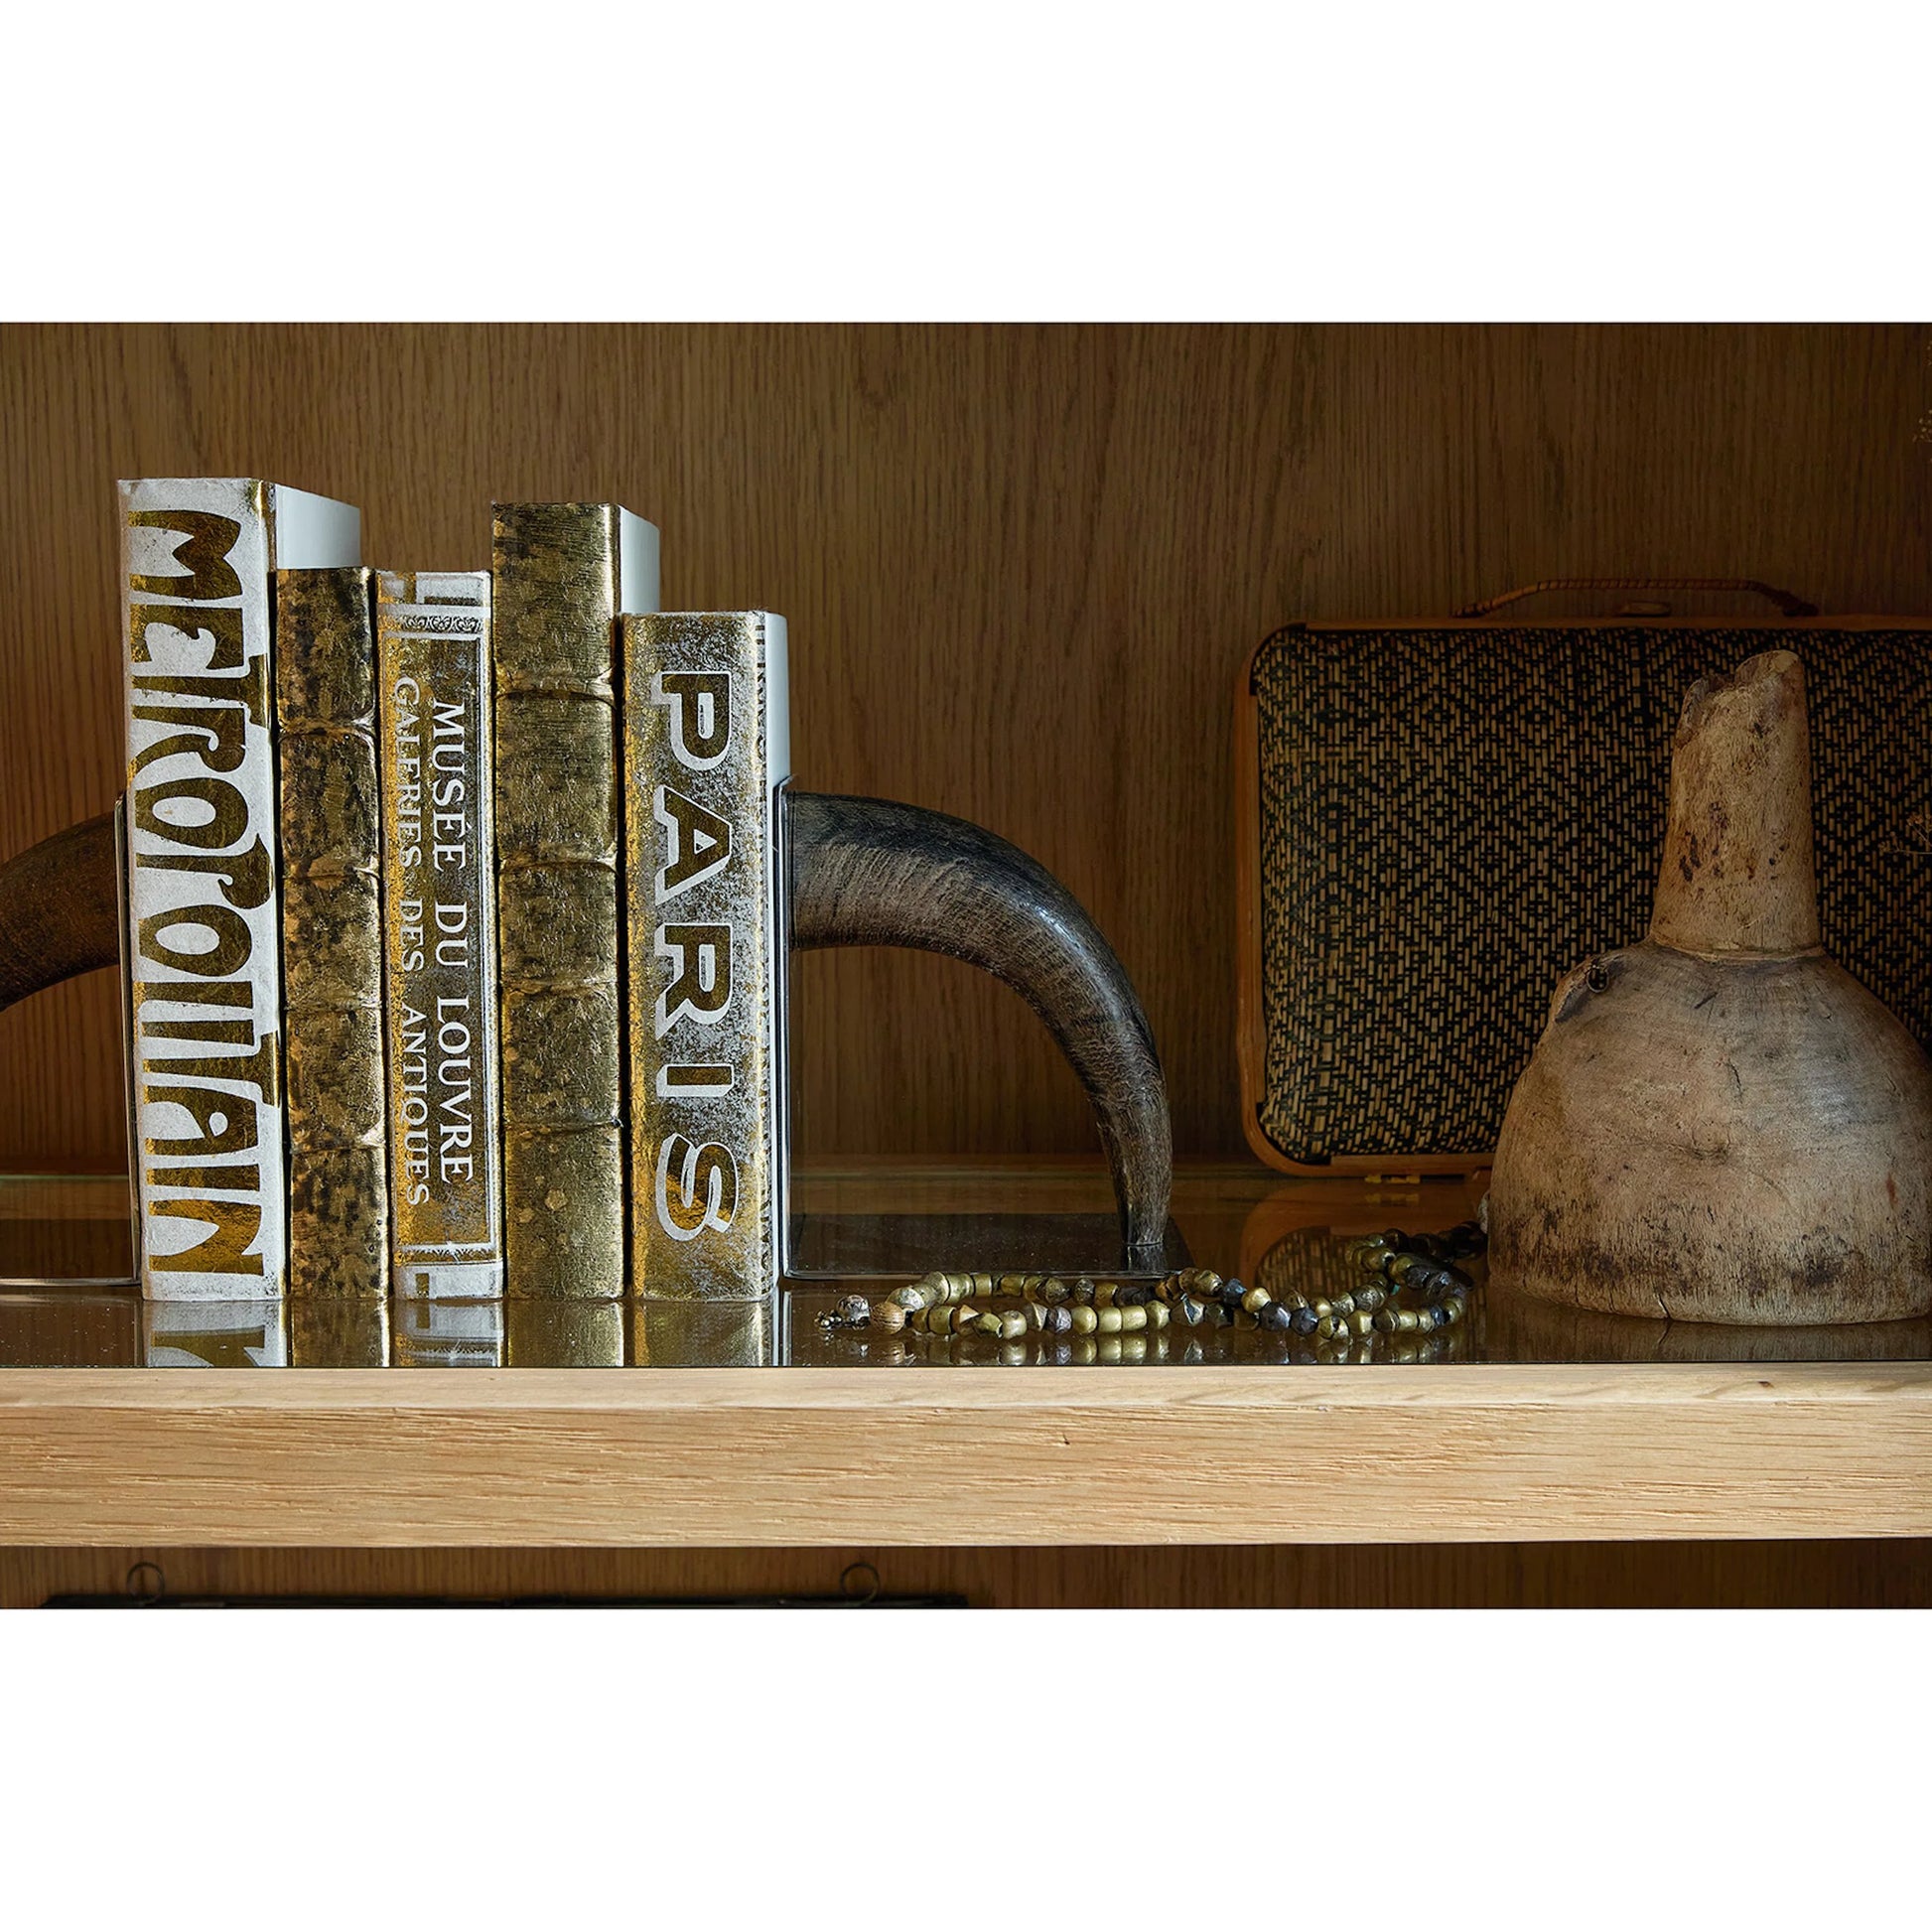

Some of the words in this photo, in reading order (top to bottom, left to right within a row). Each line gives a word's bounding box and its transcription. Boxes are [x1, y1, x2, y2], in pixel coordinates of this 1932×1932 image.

[394, 675, 422, 868] GALERIES
[431, 697, 473, 872] MUSÉE
[399, 897, 425, 972] DES
[434, 900, 470, 969] DU
[651, 671, 738, 1241] PARIS
[400, 1002, 430, 1206] ANTIQUES
[437, 995, 474, 1183] LOUVRE
